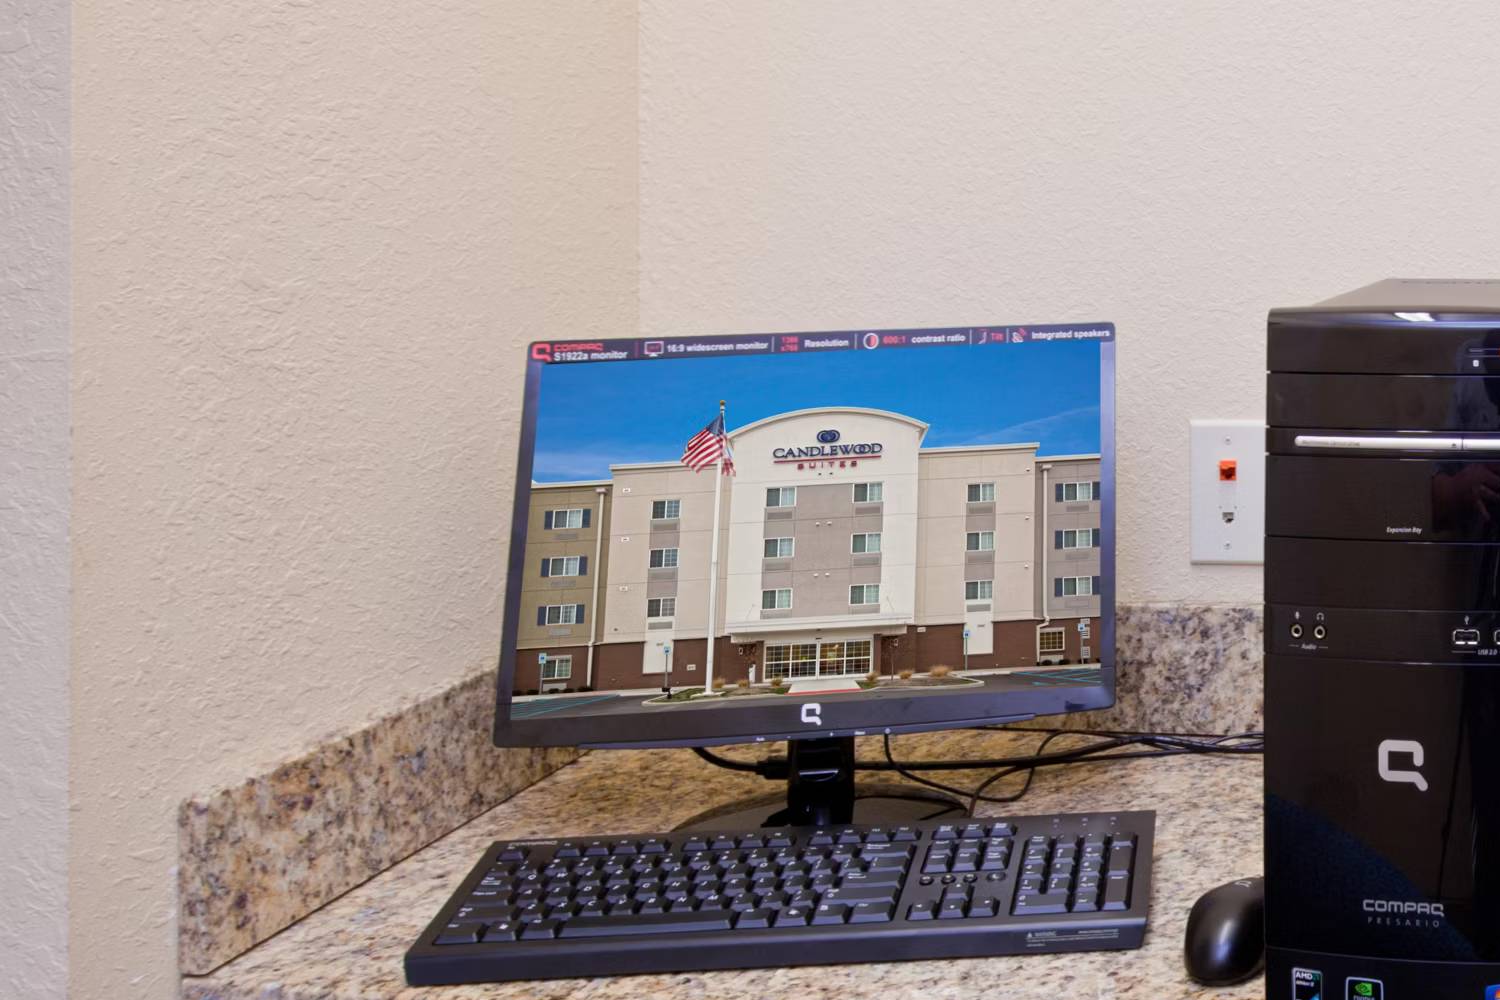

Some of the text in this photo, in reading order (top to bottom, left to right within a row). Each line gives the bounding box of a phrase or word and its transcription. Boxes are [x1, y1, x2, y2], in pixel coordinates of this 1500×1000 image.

[911, 333, 966, 343] contrast ratio
[1031, 329, 1110, 340] Integrated speakers
[686, 343, 734, 352] widescreen
[735, 341, 769, 350] monitor
[804, 339, 849, 348] Resolution
[553, 350, 628, 361] S1922a monitor
[772, 443, 883, 459] CANDLEWOOD
[797, 460, 858, 471] SUITES
[1362, 899, 1445, 917] COMPAQ
[1367, 916, 1440, 928] PRESARIO
[1295, 971, 1313, 980] AMD
